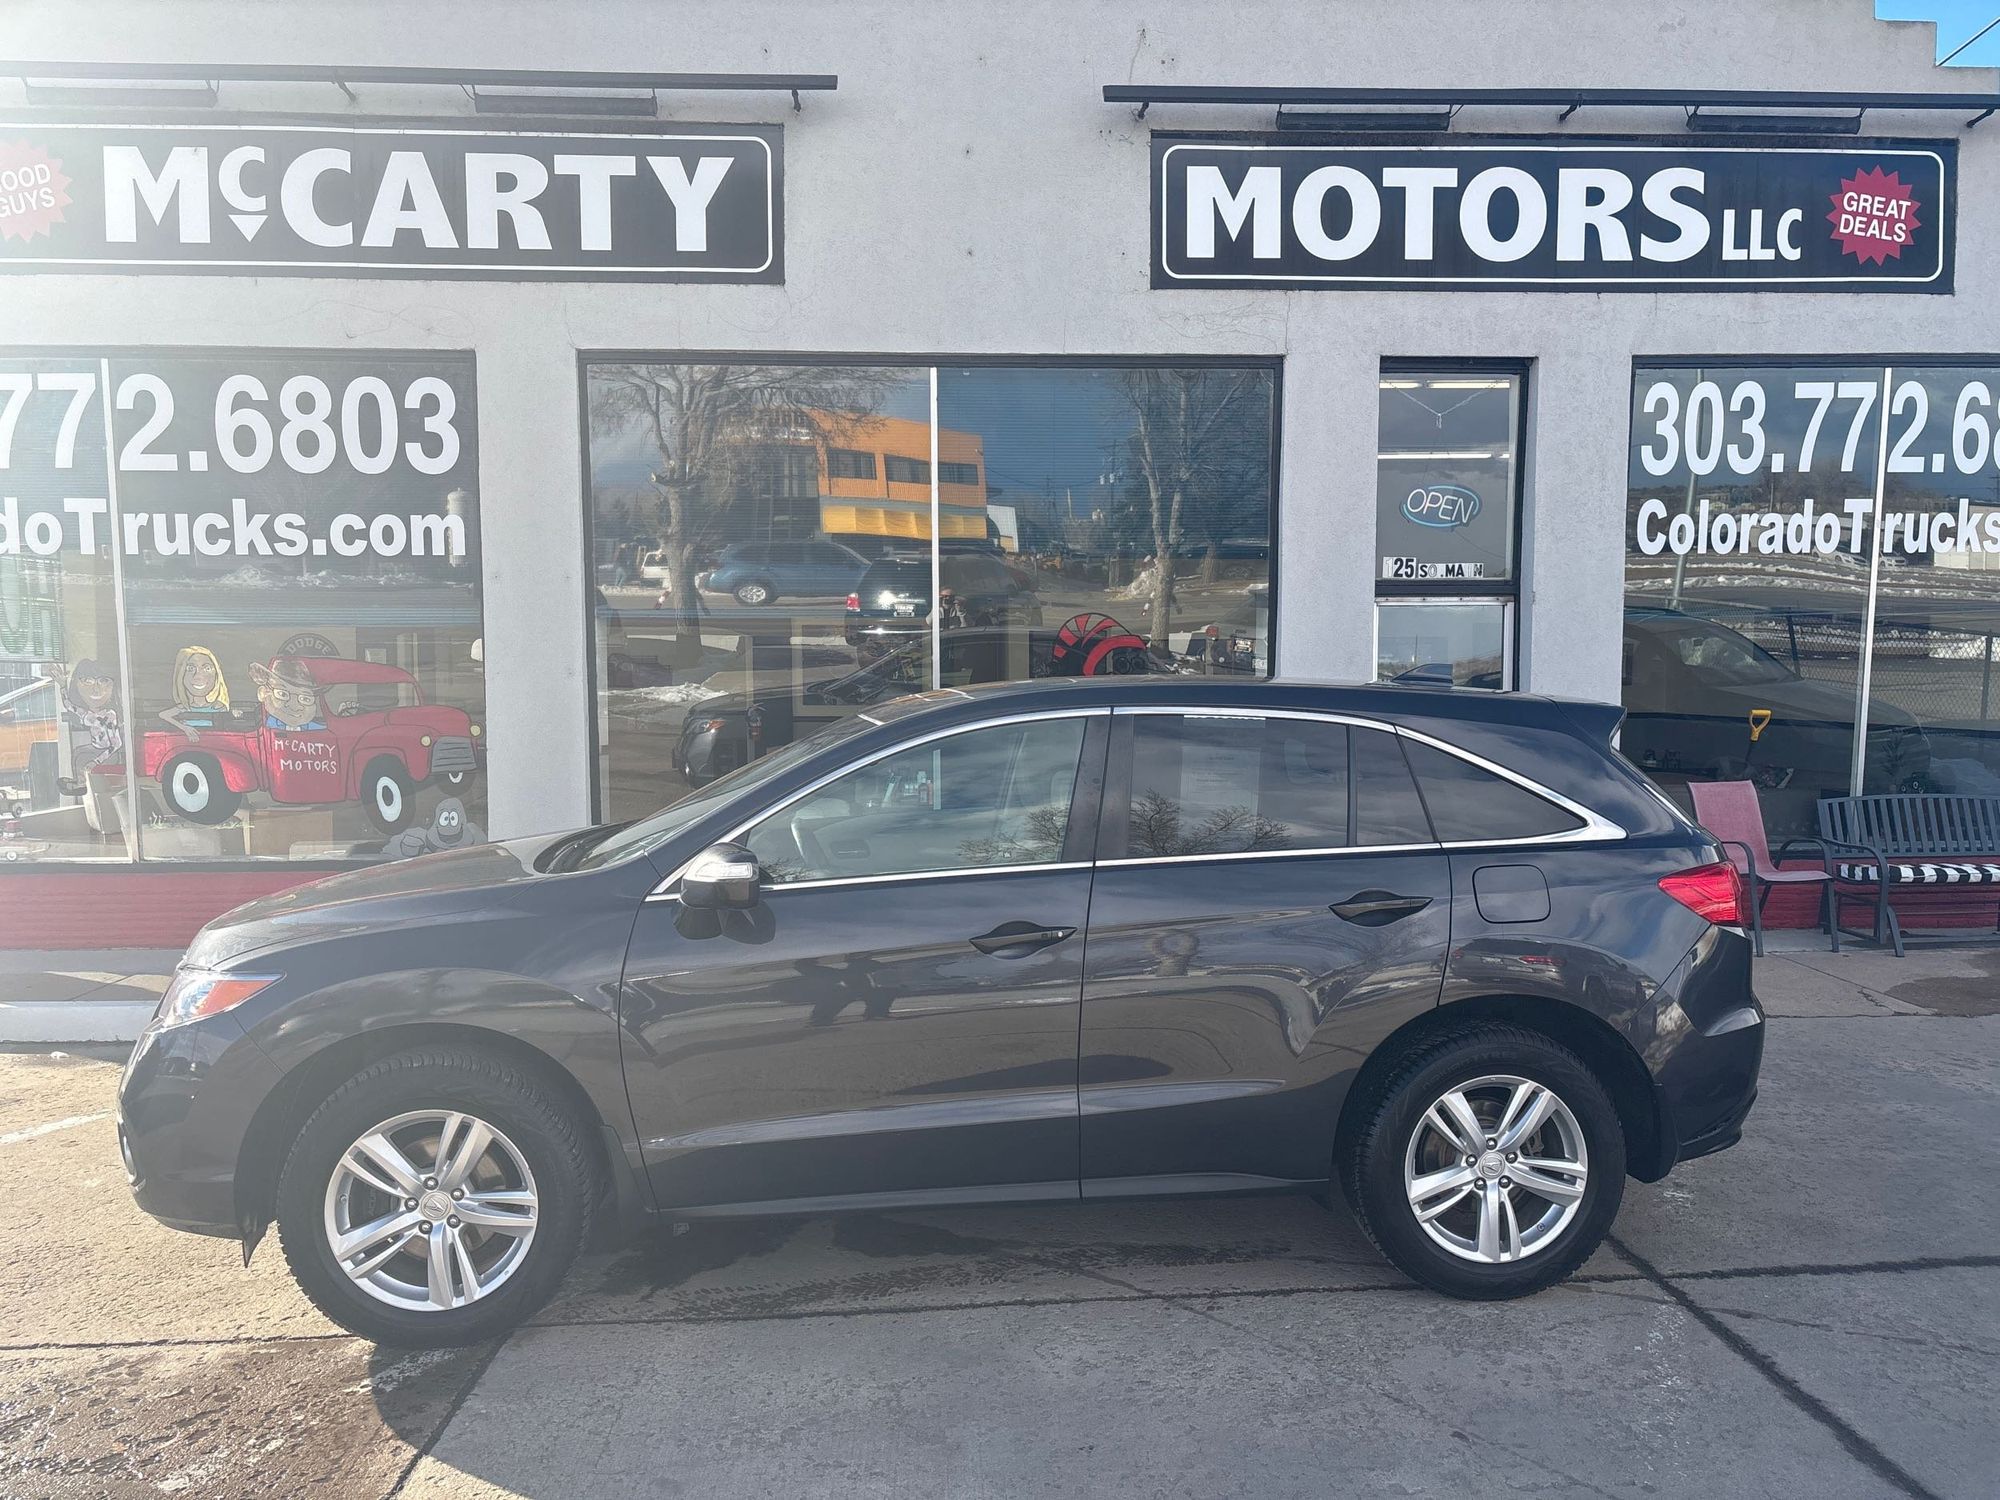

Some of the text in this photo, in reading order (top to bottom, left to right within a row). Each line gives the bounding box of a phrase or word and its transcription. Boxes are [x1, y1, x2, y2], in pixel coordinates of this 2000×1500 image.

[0, 163, 51, 193] OOD
[1186, 166, 1803, 263] MOTORS LLC
[1843, 192, 1911, 220] GREAT
[1839, 214, 1906, 242] DEALS
[1640, 380, 2000, 476] 303.772.6
[1407, 488, 1474, 523] OPEN
[285, 637, 331, 655] DODGE
[280, 758, 337, 775] MOTORS
